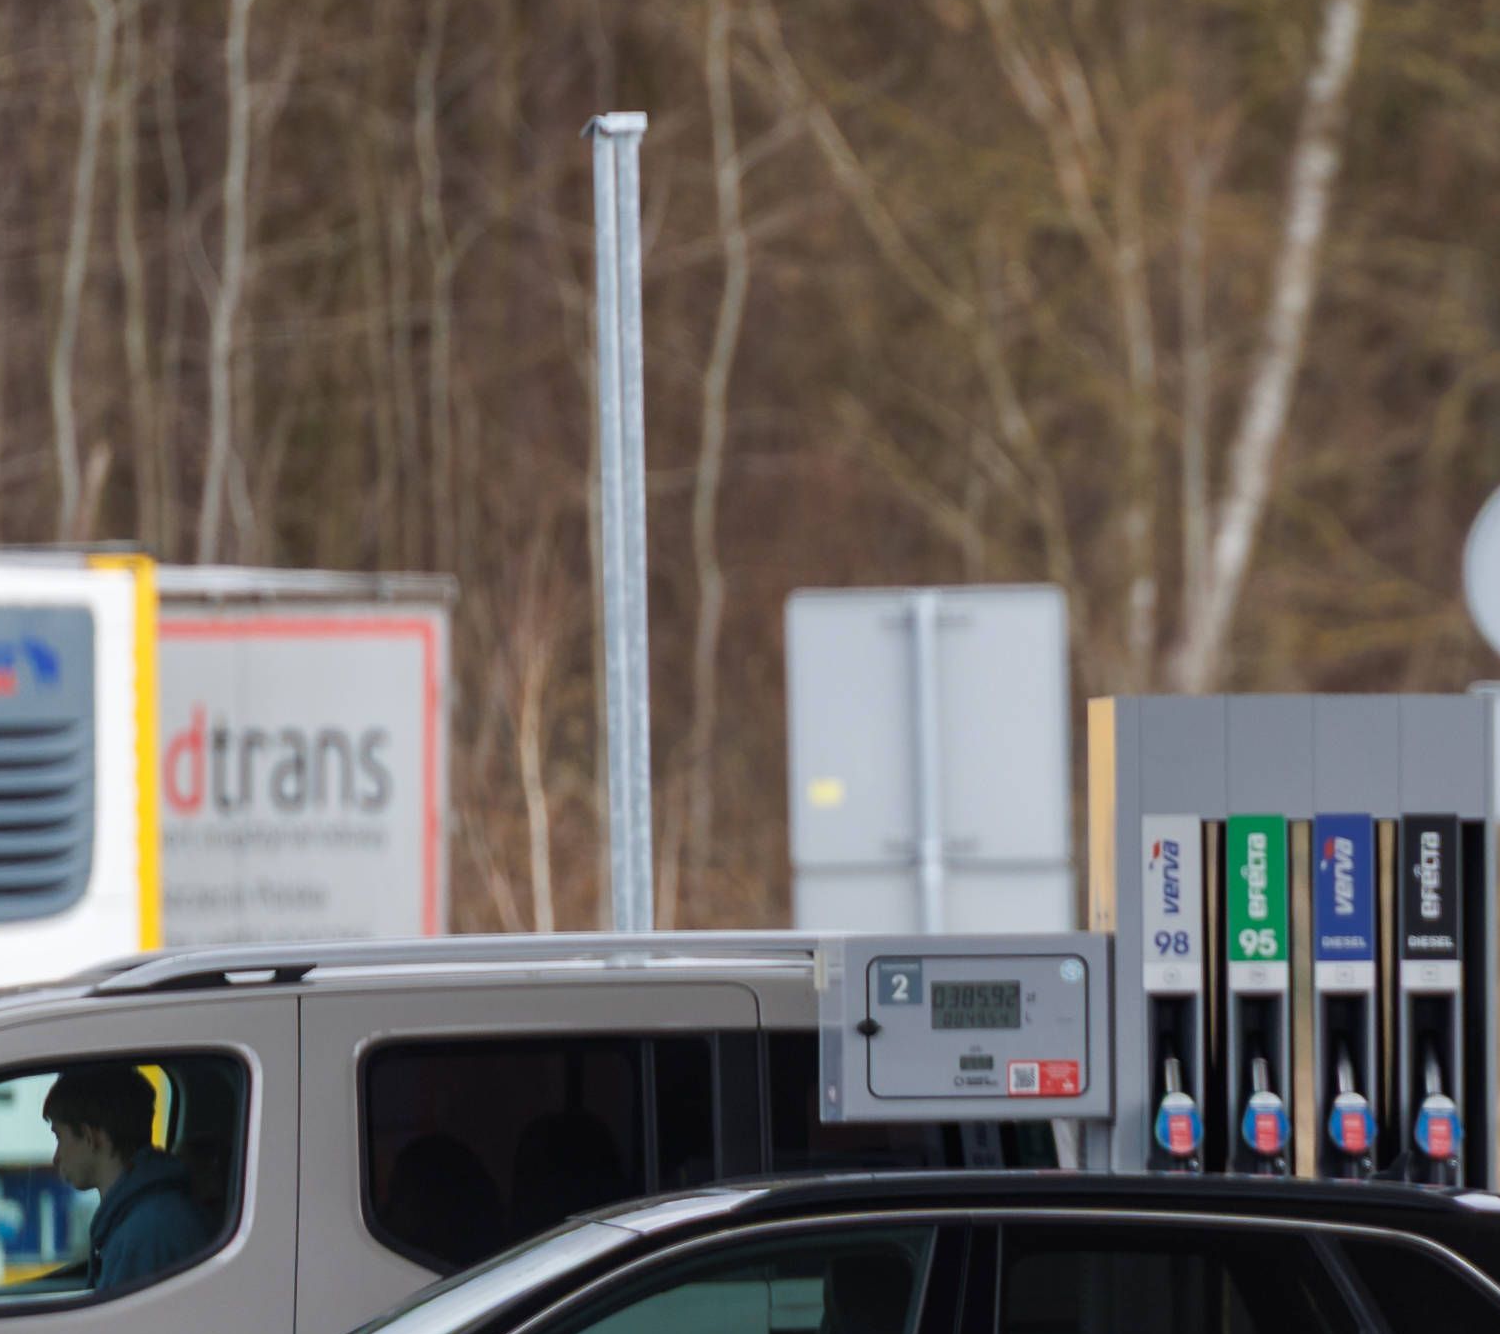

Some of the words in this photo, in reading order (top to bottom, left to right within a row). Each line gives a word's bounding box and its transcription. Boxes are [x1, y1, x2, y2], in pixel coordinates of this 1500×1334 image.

[161, 699, 394, 816] dtrans
[1162, 838, 1181, 915] verva
[1333, 836, 1355, 916] verva
[1154, 930, 1190, 955] 98
[1238, 928, 1278, 956] 95
[1321, 934, 1368, 949] DIESEL
[1407, 934, 1455, 949] DIESEL
[891, 973, 909, 1002] 2
